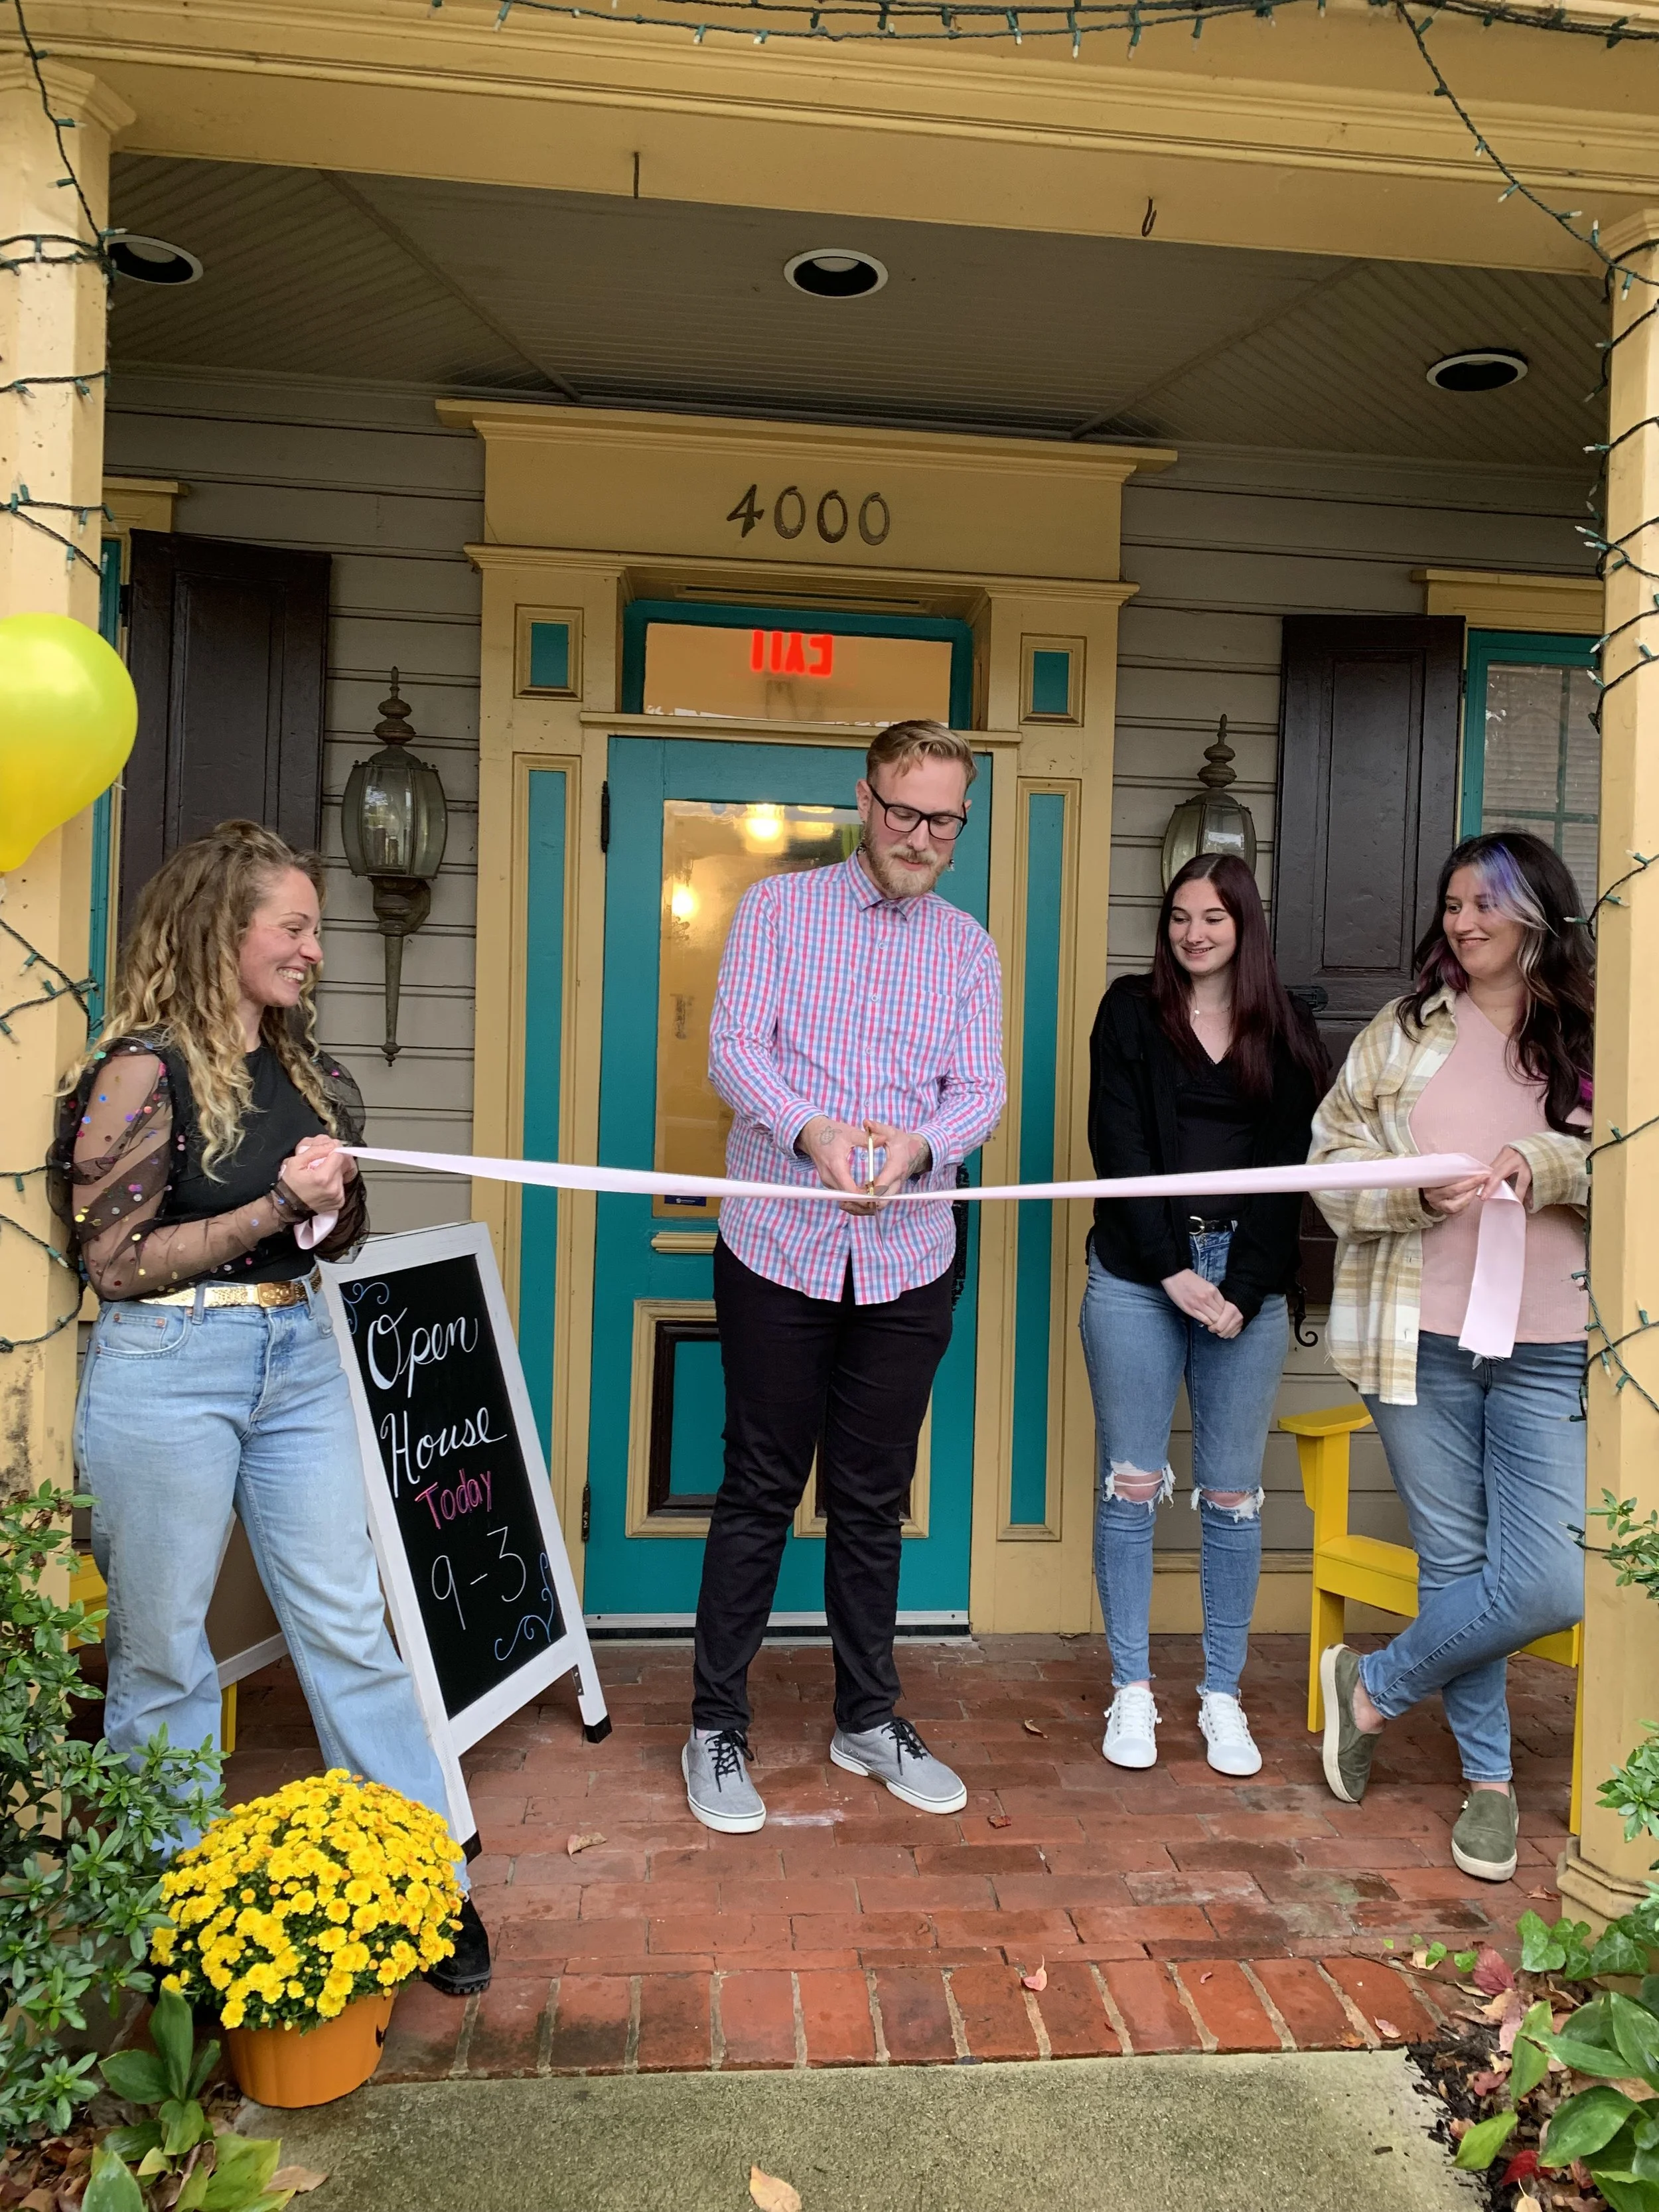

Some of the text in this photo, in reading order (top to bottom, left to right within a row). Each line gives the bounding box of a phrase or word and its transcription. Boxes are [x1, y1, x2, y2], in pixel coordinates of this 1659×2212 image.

[727, 484, 890, 546] 4000
[367, 1307, 478, 1398] Open
[380, 1407, 507, 1499] House
[415, 1469, 492, 1529] Today
